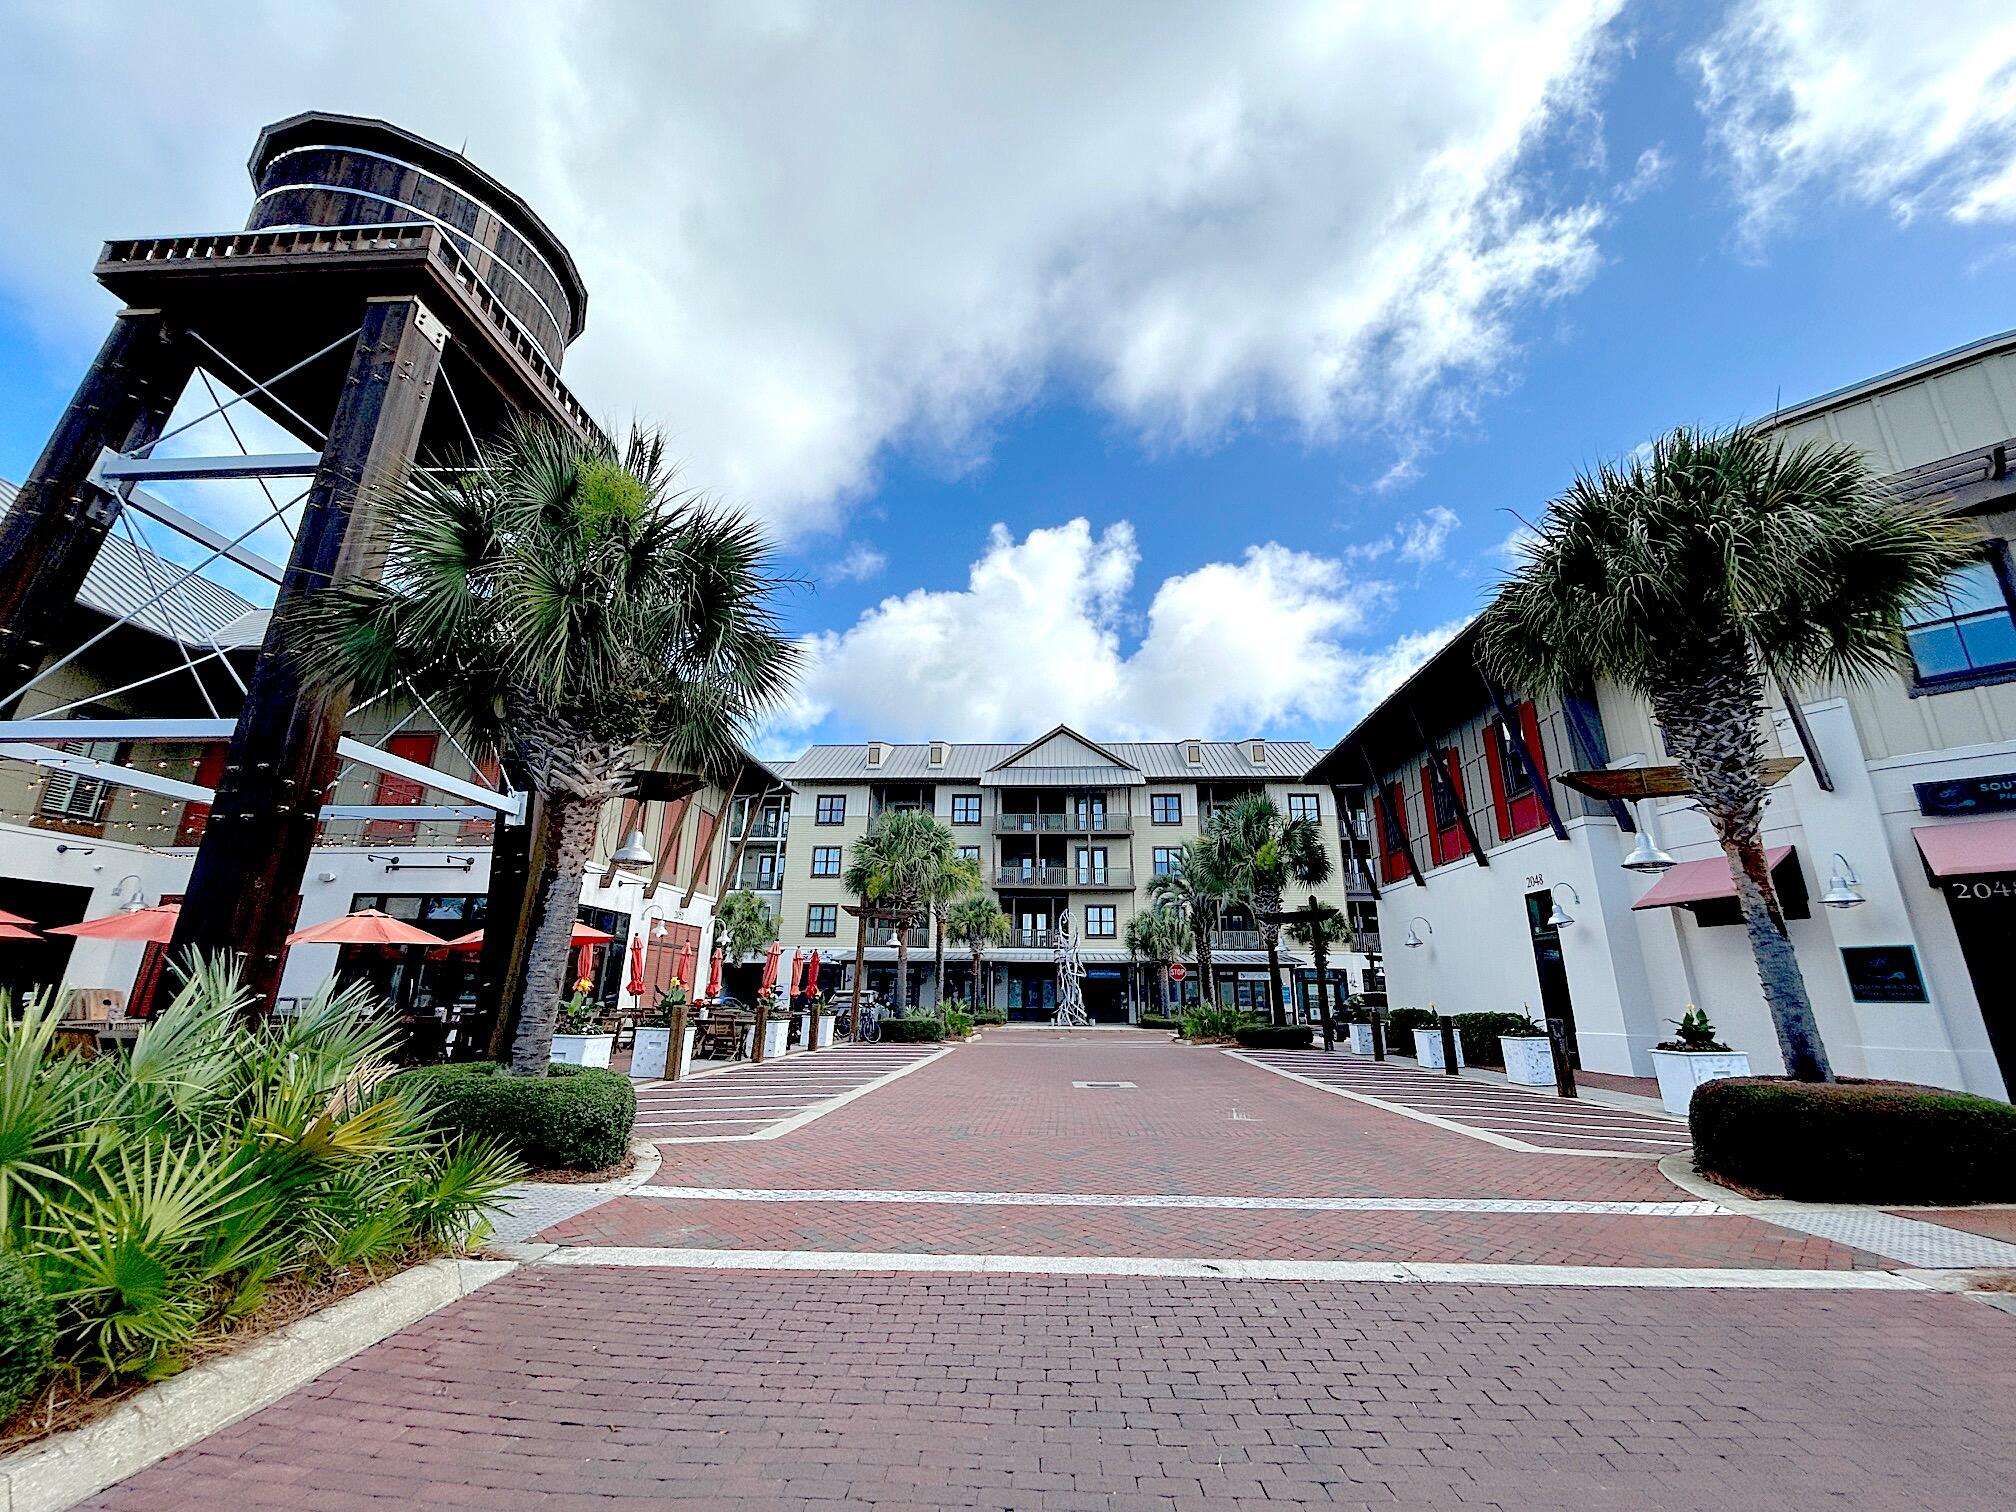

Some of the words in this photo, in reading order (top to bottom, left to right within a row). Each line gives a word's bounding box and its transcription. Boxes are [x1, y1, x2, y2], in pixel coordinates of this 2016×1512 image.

[1526, 873, 1544, 888] 2048
[1952, 881, 2016, 899] 204
[1170, 968, 1186, 976] STOP
